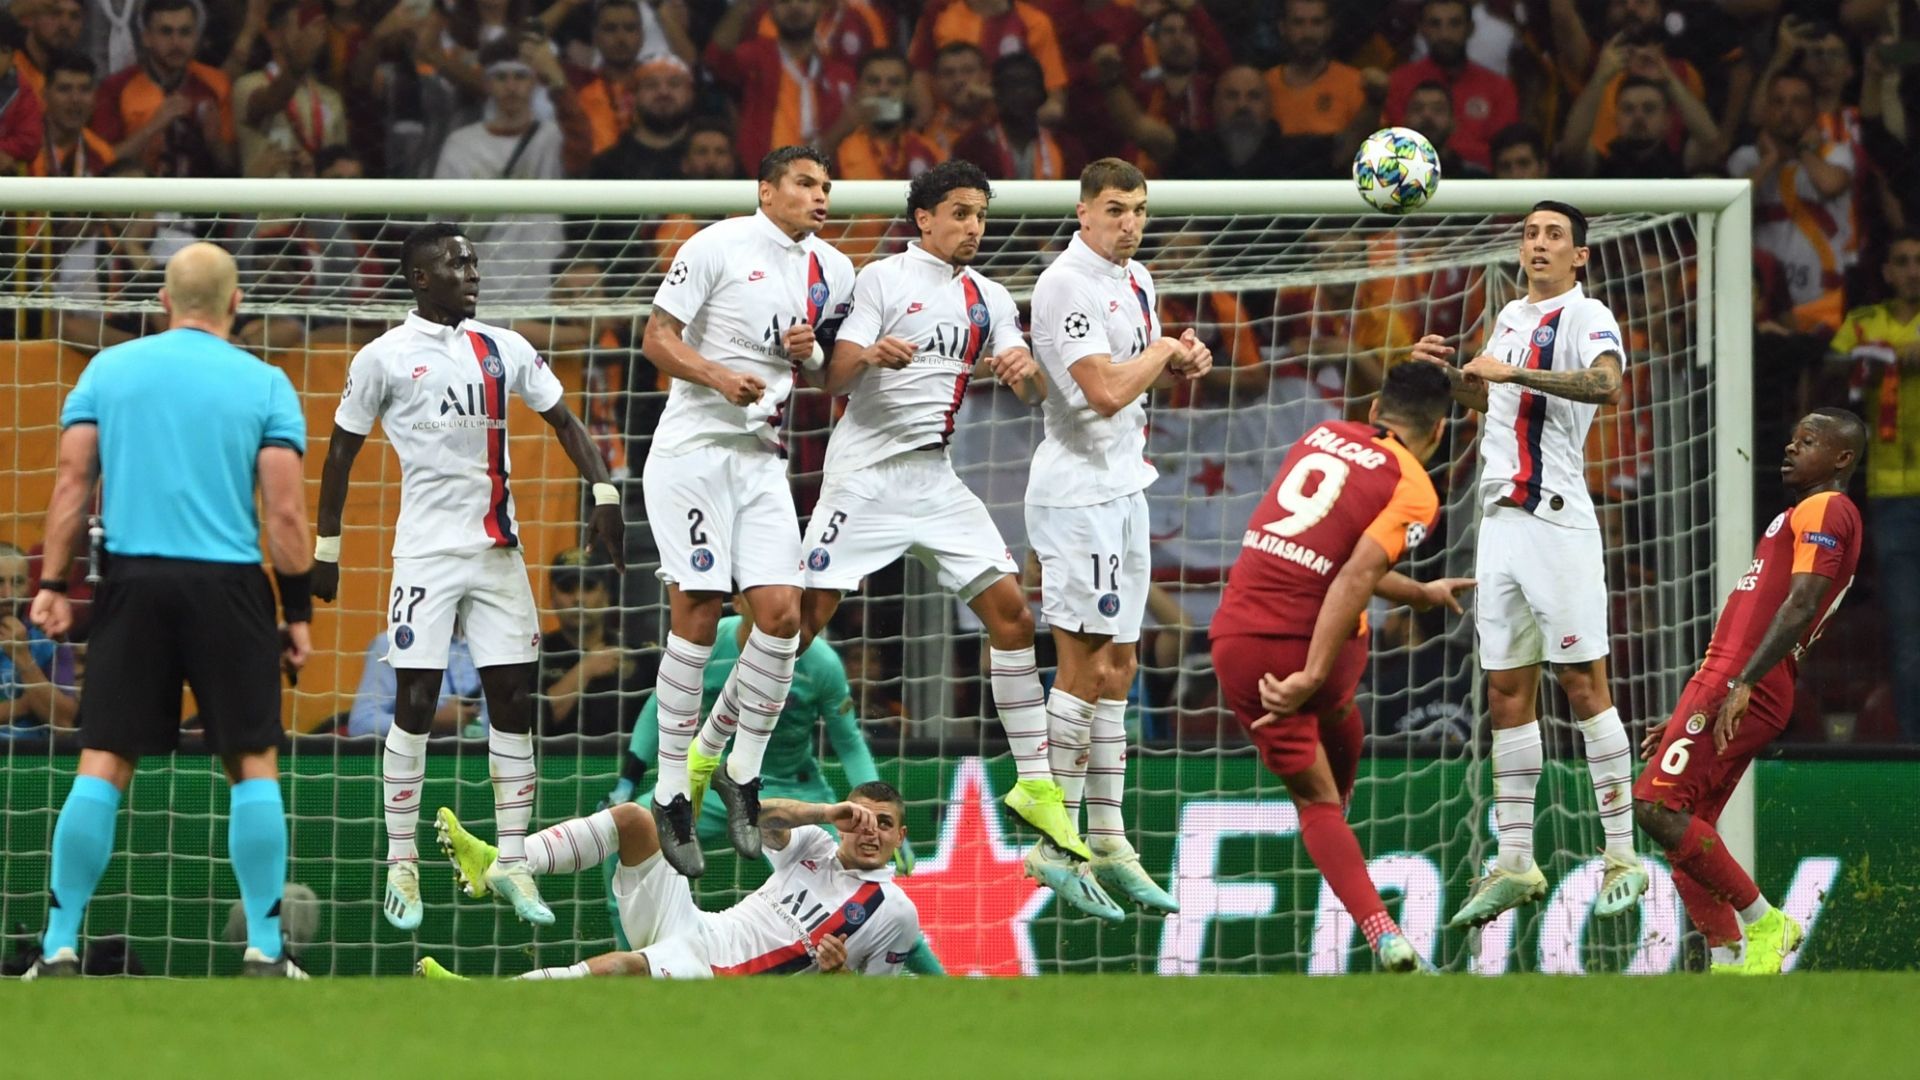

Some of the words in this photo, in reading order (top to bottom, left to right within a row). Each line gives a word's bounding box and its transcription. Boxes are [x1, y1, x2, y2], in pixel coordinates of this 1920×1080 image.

[449, 419, 469, 429] LIVE
[1304, 426, 1387, 470] FALCAO
[1262, 452, 1350, 537] 9
[688, 508, 708, 546] 2
[820, 510, 848, 544] 5
[1810, 534, 1837, 547] RESPECT
[1091, 553, 1119, 591] 12
[1242, 530, 1333, 576] GALATASARAY
[392, 586, 427, 623] 27
[1660, 737, 1695, 776] 6
